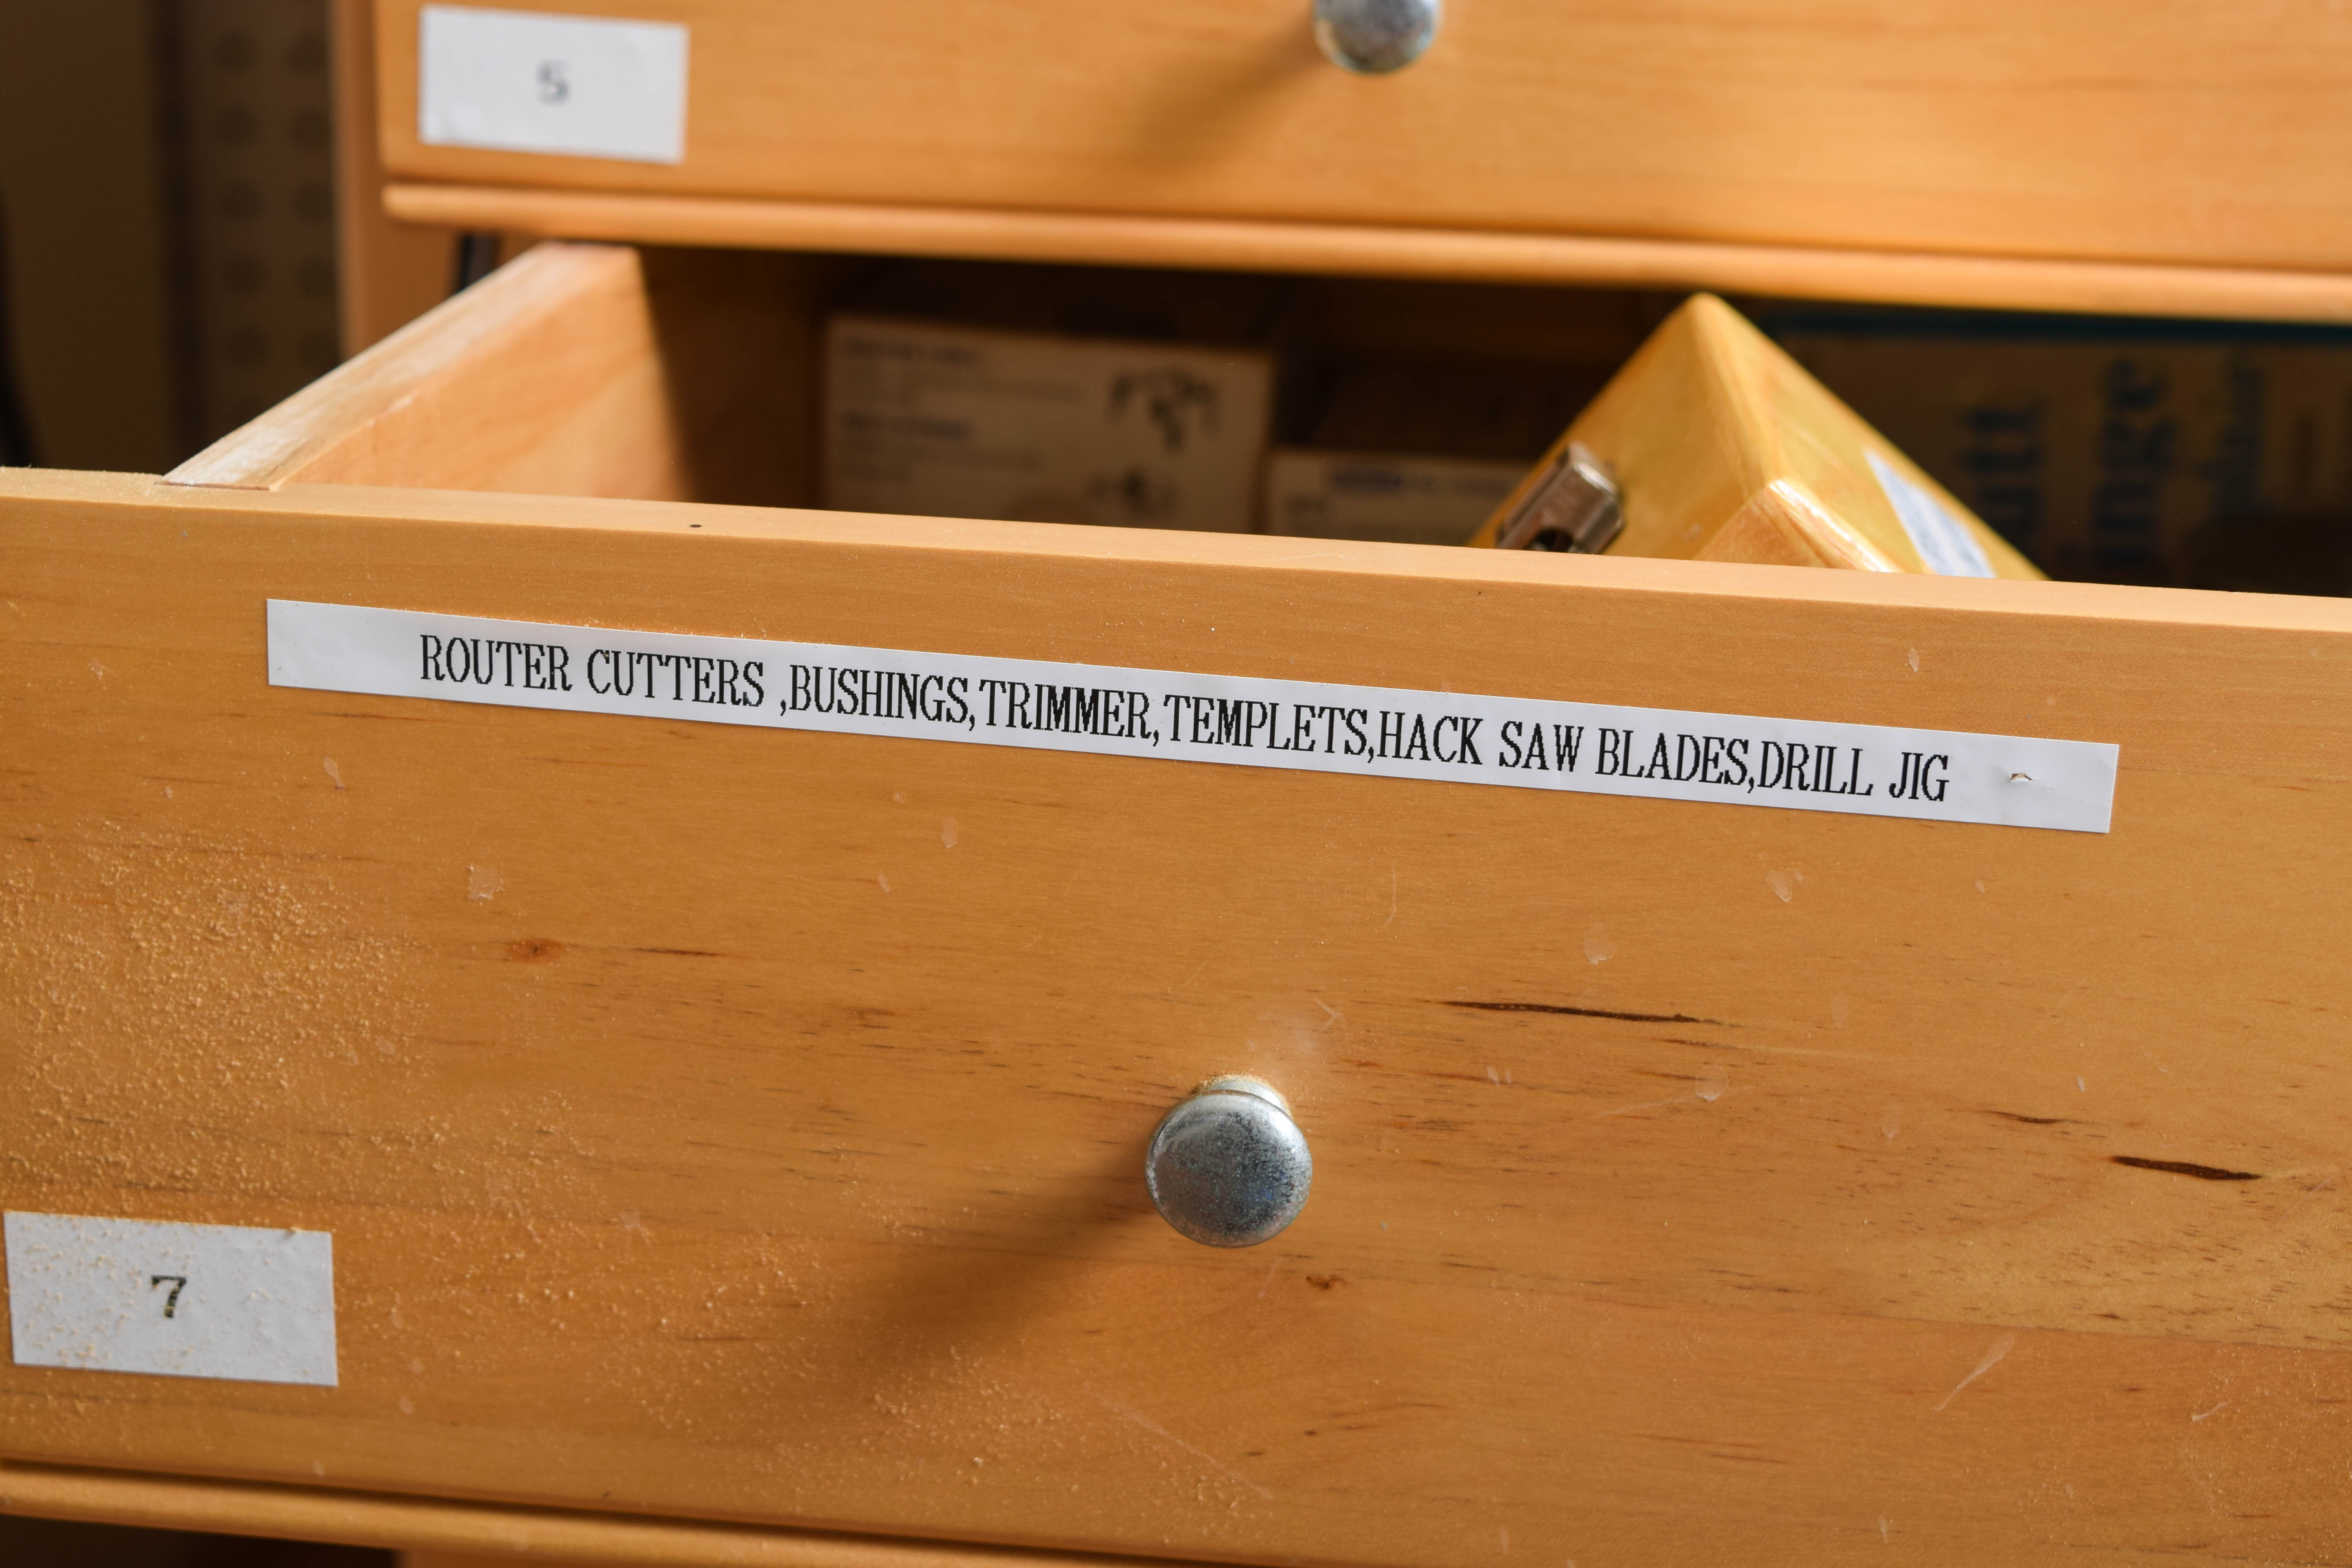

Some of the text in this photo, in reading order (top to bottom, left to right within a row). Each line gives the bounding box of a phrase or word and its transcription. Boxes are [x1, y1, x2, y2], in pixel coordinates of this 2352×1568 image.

[537, 61, 570, 105] 5
[420, 634, 573, 691] ROUTER
[587, 649, 764, 707] CUTTERS
[1498, 720, 1585, 773] SAW
[1888, 751, 1950, 802] JIG
[151, 1275, 187, 1318] 7
